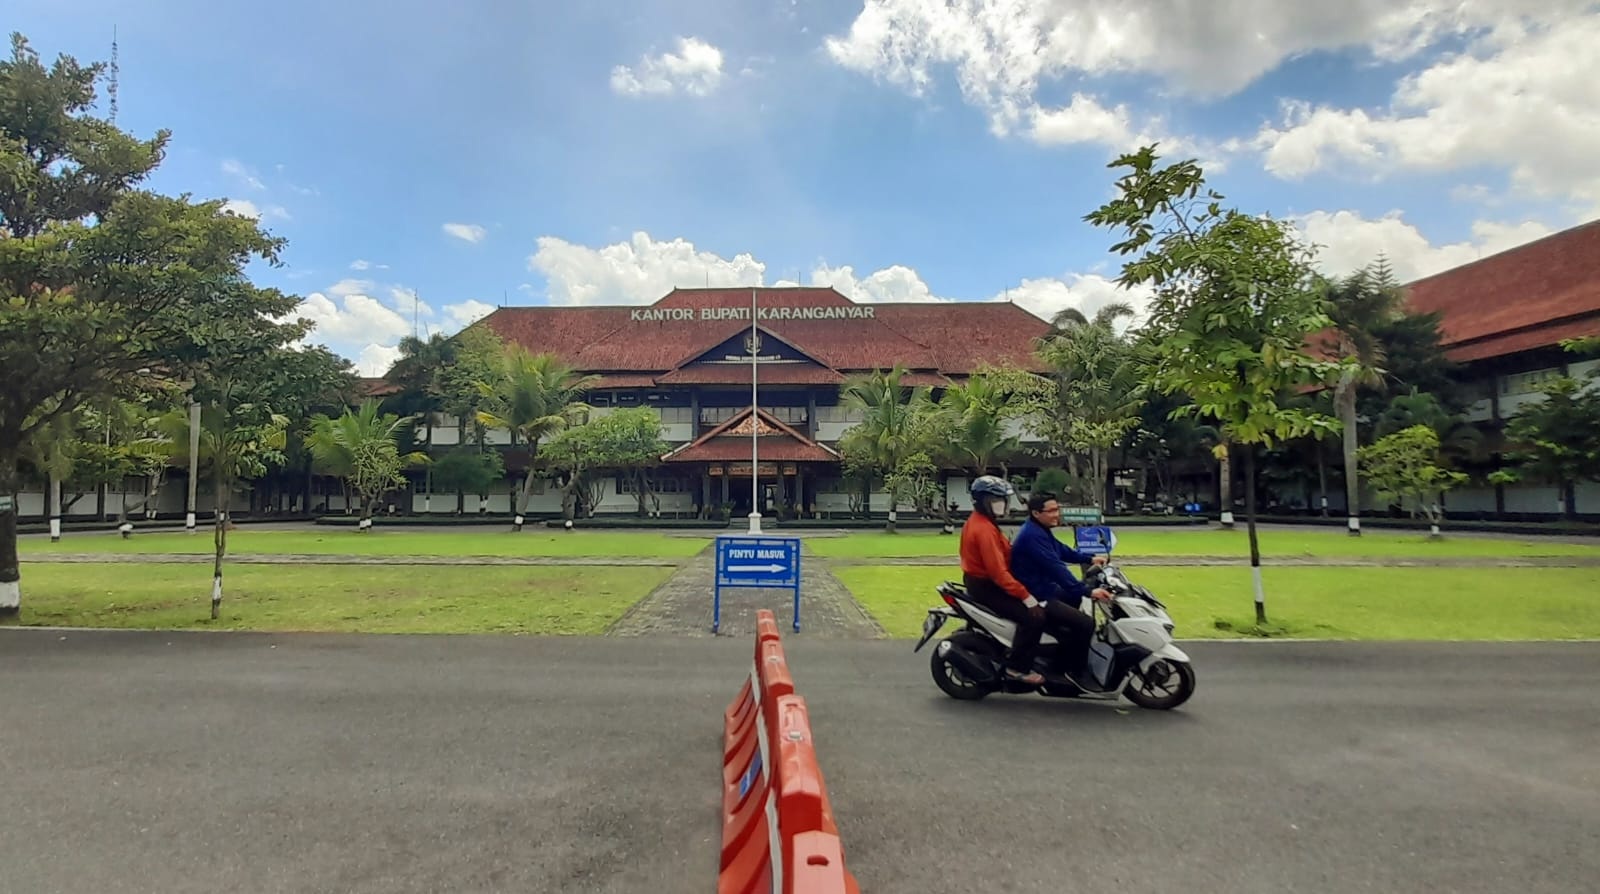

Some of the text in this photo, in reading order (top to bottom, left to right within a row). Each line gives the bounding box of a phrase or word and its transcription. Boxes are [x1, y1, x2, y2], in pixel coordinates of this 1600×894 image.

[631, 306, 875, 320] KANTOR BUPATI KARANGANYAR
[729, 549, 785, 559] PINTU MASUK
